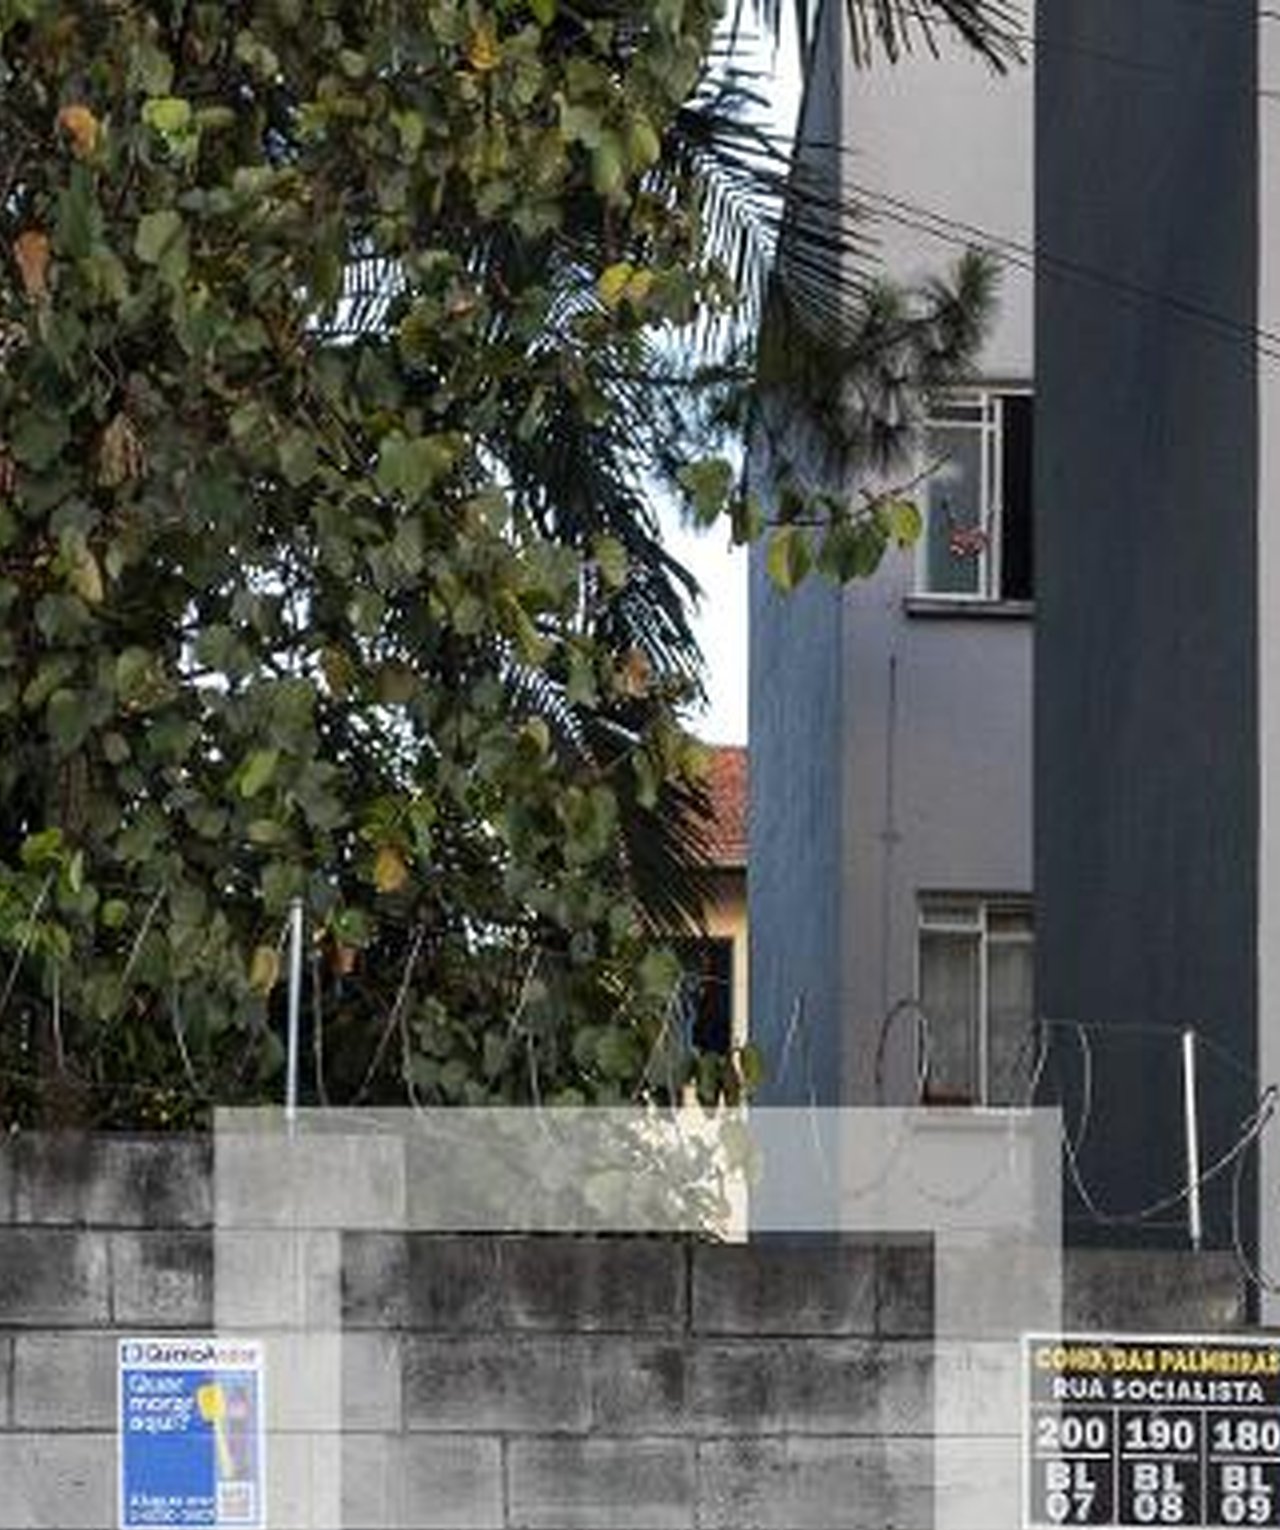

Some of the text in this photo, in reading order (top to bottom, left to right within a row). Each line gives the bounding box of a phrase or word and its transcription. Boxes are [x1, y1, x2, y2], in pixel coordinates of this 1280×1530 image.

[1113, 1350, 1154, 1371] DAS
[1052, 1377, 1264, 1402] RUA SOCIALISTA
[1036, 1417, 1105, 1449] 200
[1124, 1418, 1193, 1450] 190
[1213, 1420, 1280, 1451] 180
[1045, 1462, 1096, 1490] BL
[1133, 1463, 1184, 1491] BL
[1222, 1465, 1272, 1493] BL
[1045, 1493, 1095, 1520] 07
[1133, 1494, 1183, 1521] 08
[1221, 1496, 1271, 1523] 09
